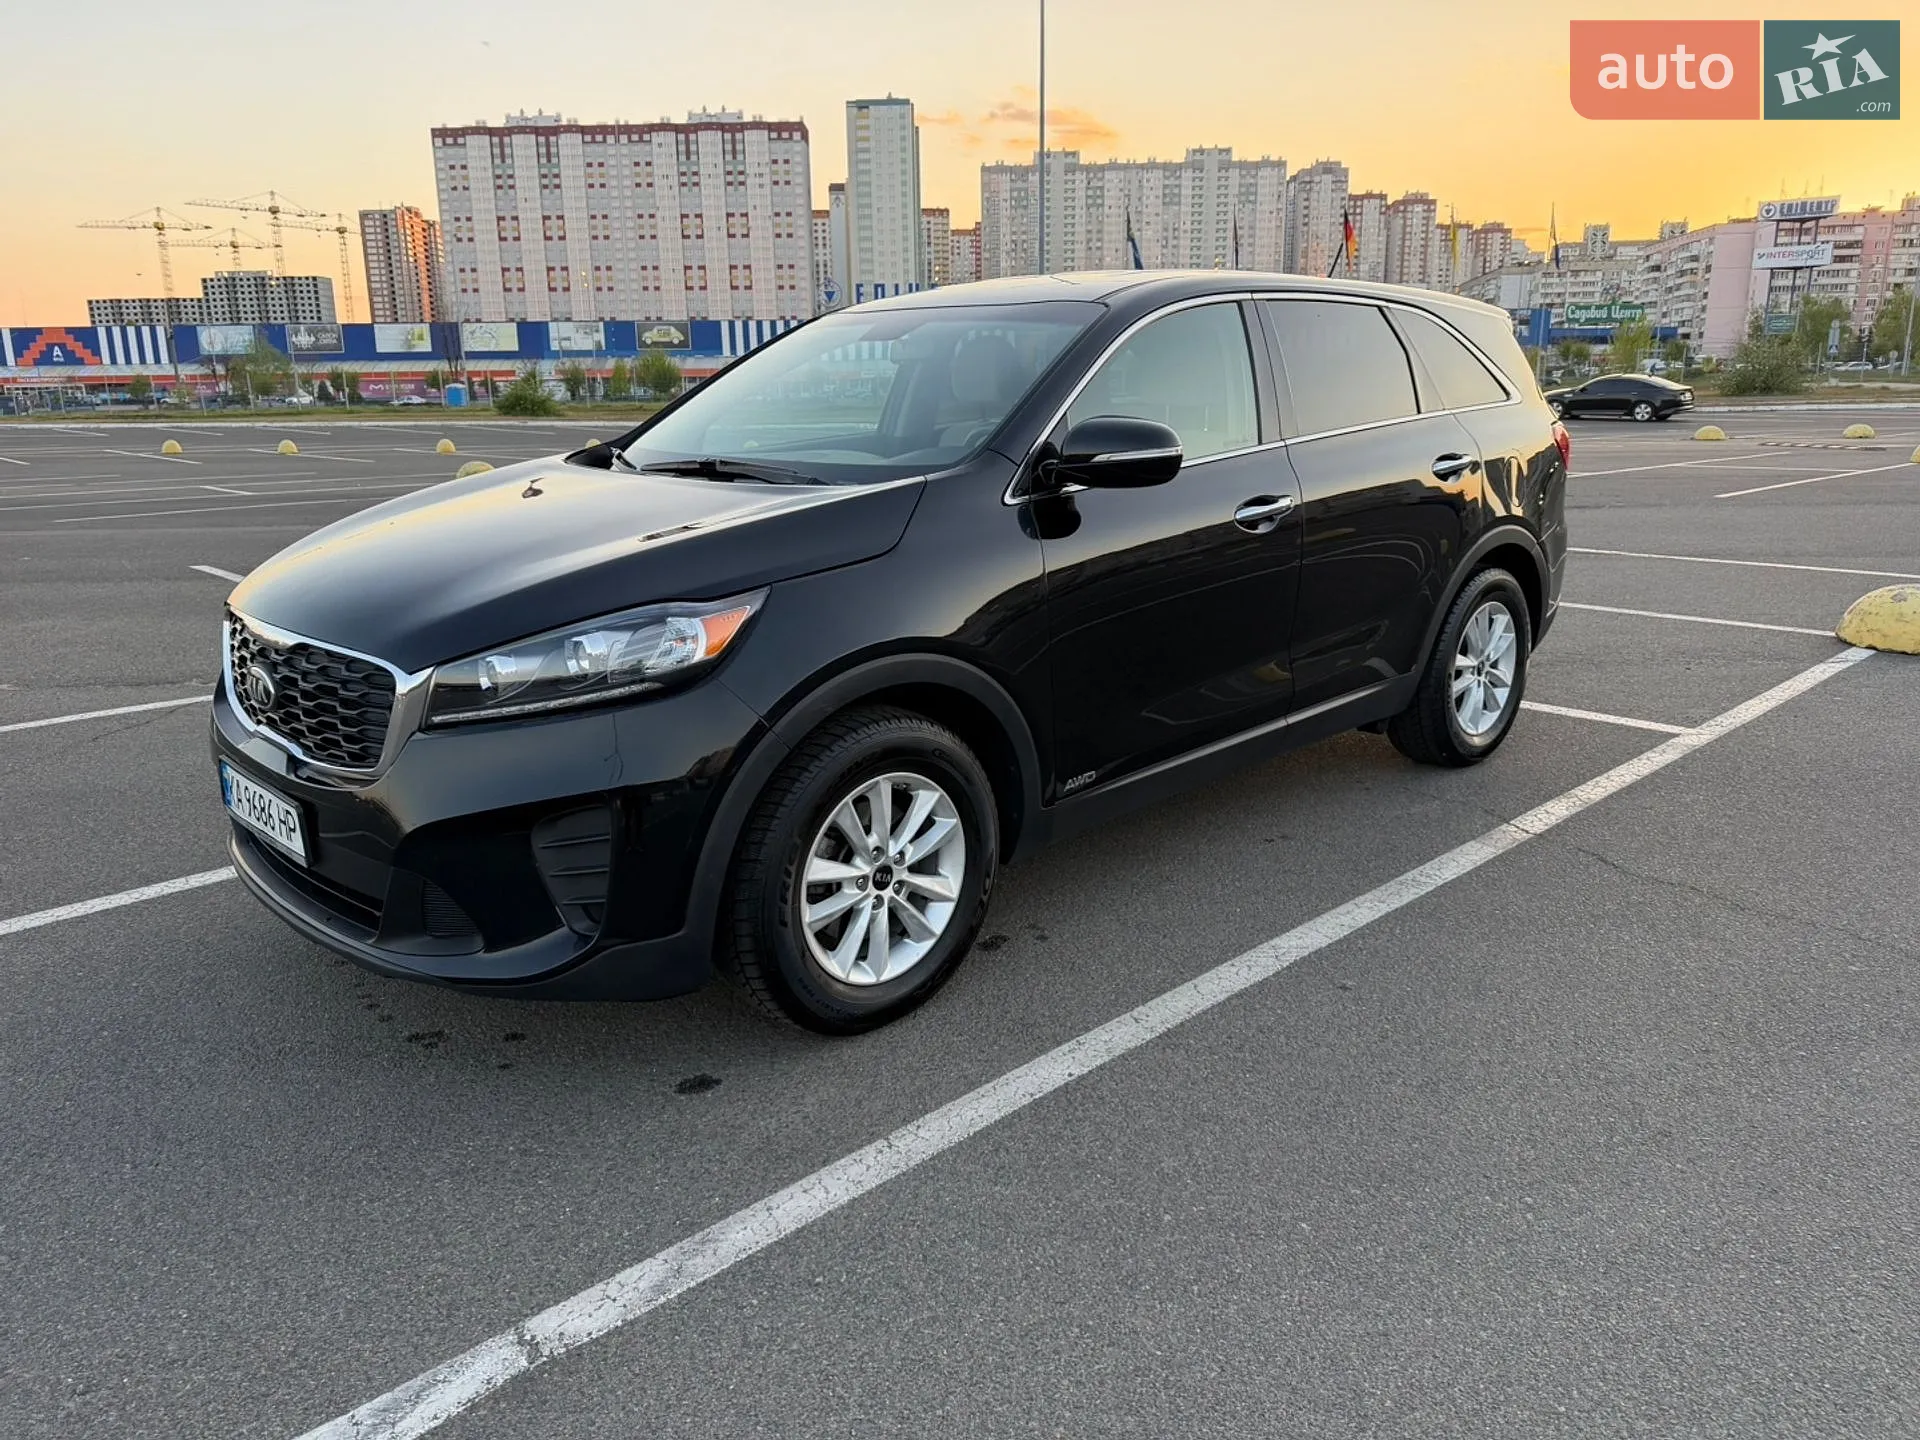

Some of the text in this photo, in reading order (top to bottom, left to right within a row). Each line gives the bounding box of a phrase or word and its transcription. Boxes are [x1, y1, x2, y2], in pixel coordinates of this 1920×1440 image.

[1766, 248, 1826, 260] INTERSPORT
[1611, 305, 1643, 321] Центр
[1064, 770, 1096, 792] AWD
[244, 785, 275, 832] 9686
[276, 803, 296, 842] HP
[875, 872, 891, 883] KIA
